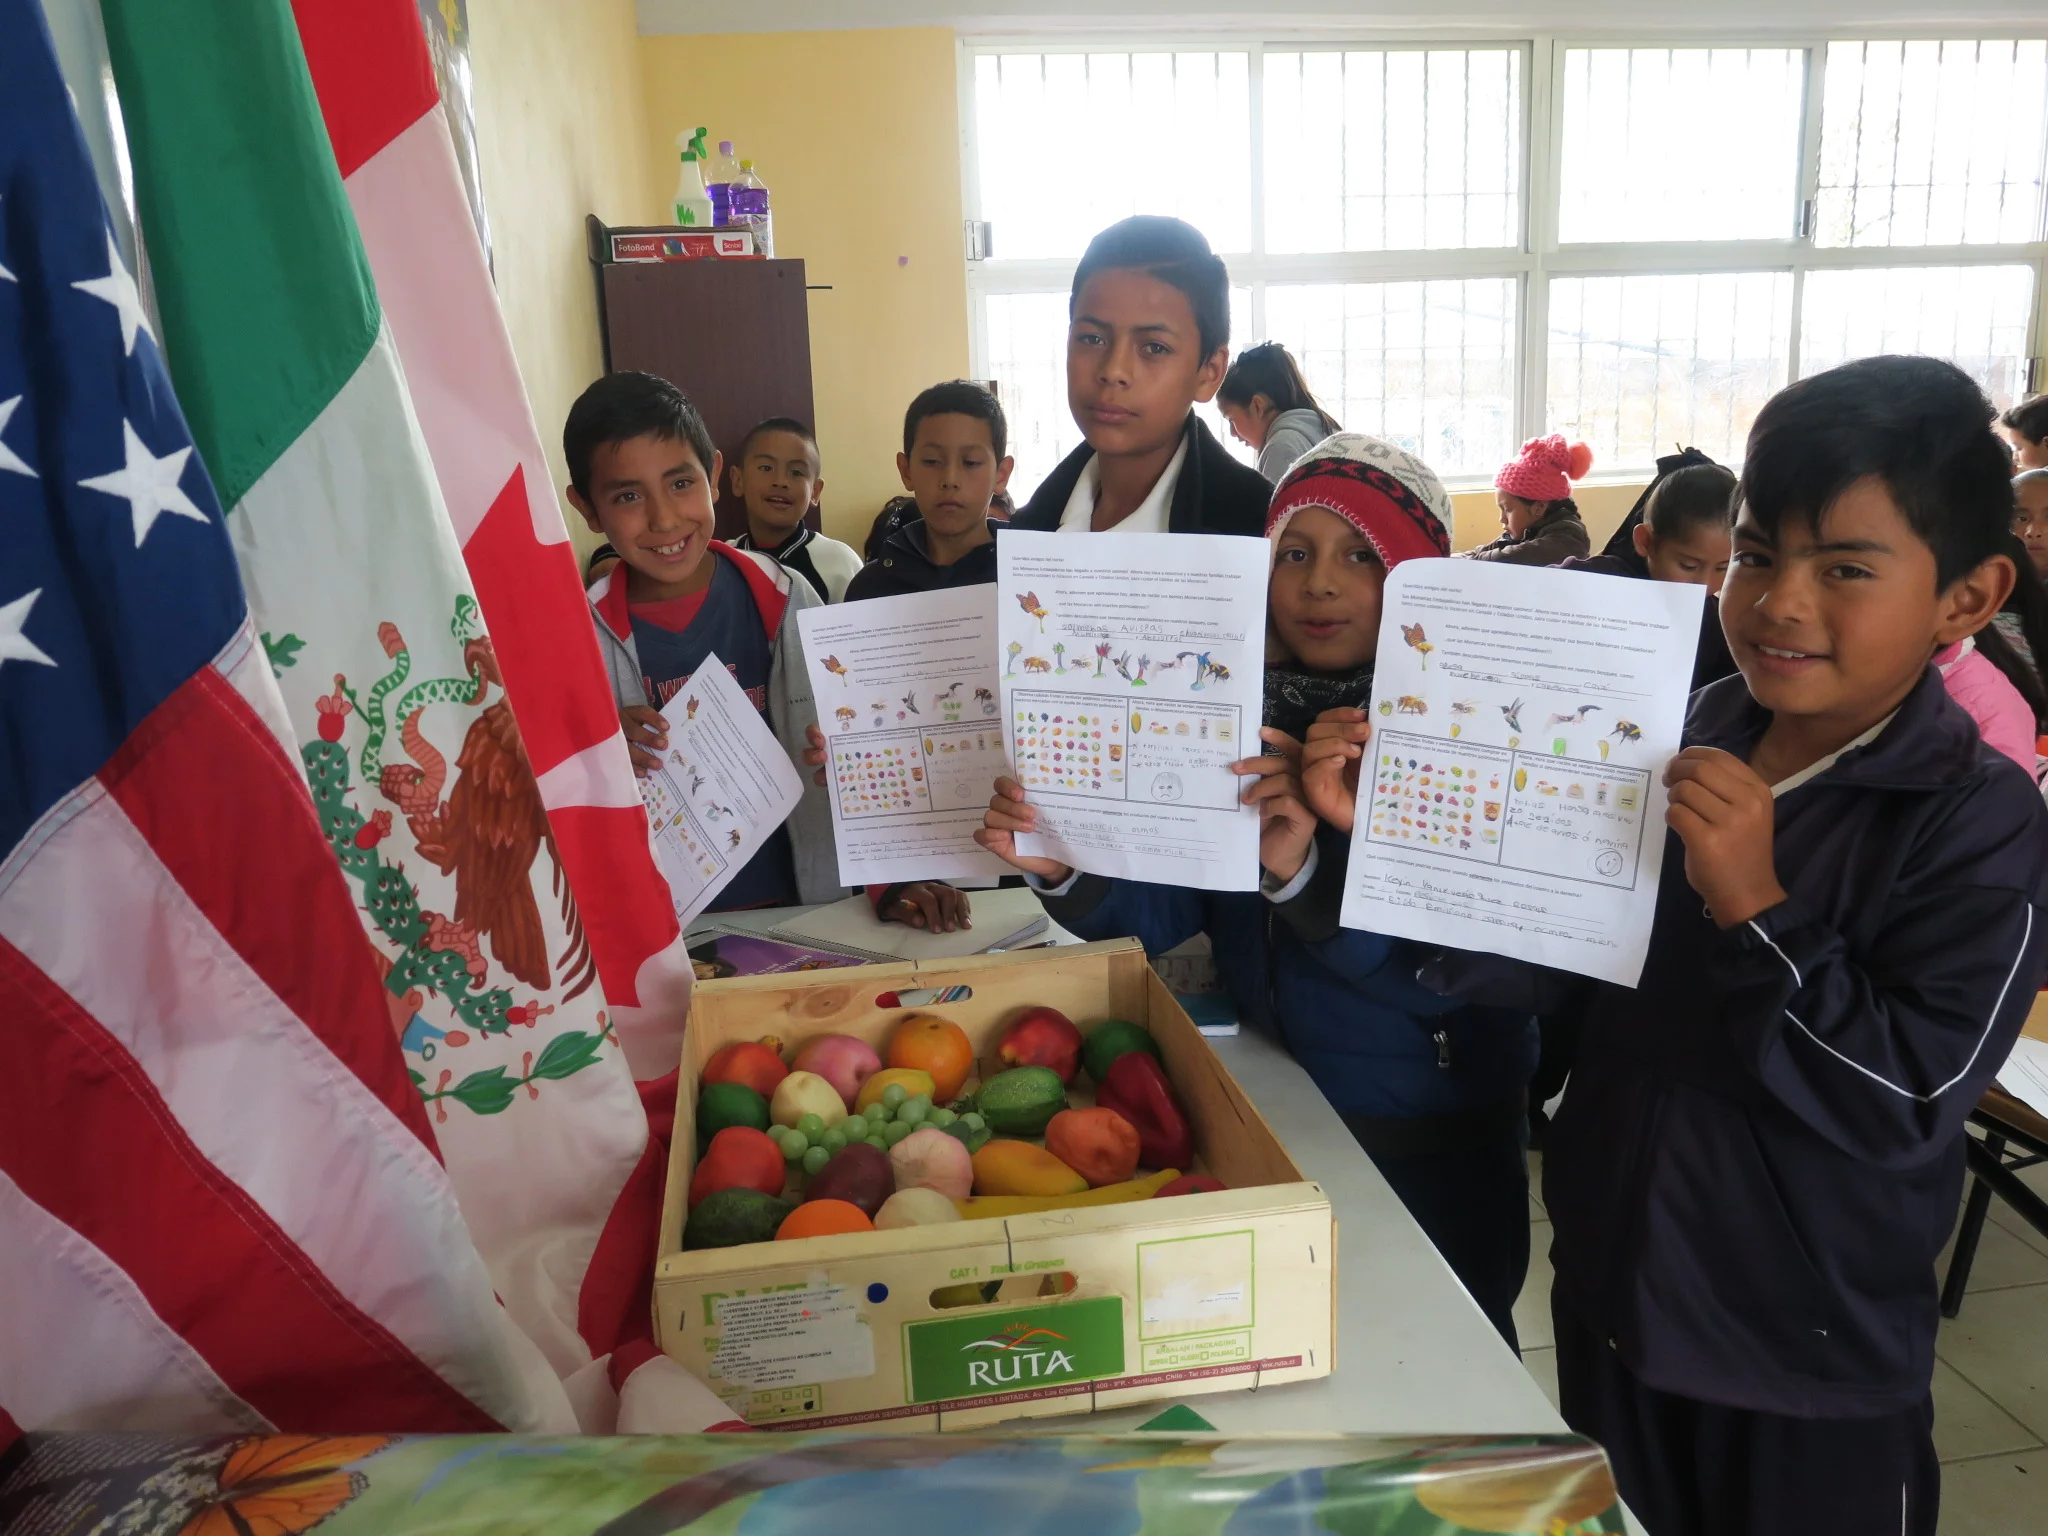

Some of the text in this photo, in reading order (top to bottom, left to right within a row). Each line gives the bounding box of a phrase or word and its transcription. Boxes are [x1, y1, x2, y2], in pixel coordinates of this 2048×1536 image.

[618, 243, 655, 252] FotoBond
[723, 241, 741, 249] Scribe
[949, 1266, 978, 1279] CAT 1
[990, 1259, 1065, 1275] Tabe Grapes
[1195, 1339, 1237, 1350] PACKAGING
[967, 1349, 1077, 1387] RUTA
[823, 1412, 880, 1425] EXPORTADORA
[882, 1407, 910, 1418] SERGIO
[912, 1405, 930, 1414] RUIZ
[957, 1396, 992, 1408] HUMERES
[1044, 1388, 1056, 1396] Las
[1058, 1384, 1087, 1394] Condes
[1088, 1381, 1108, 1391] 1400
[1165, 1371, 1183, 1380] Chile
[1188, 1370, 1198, 1378] Tel
